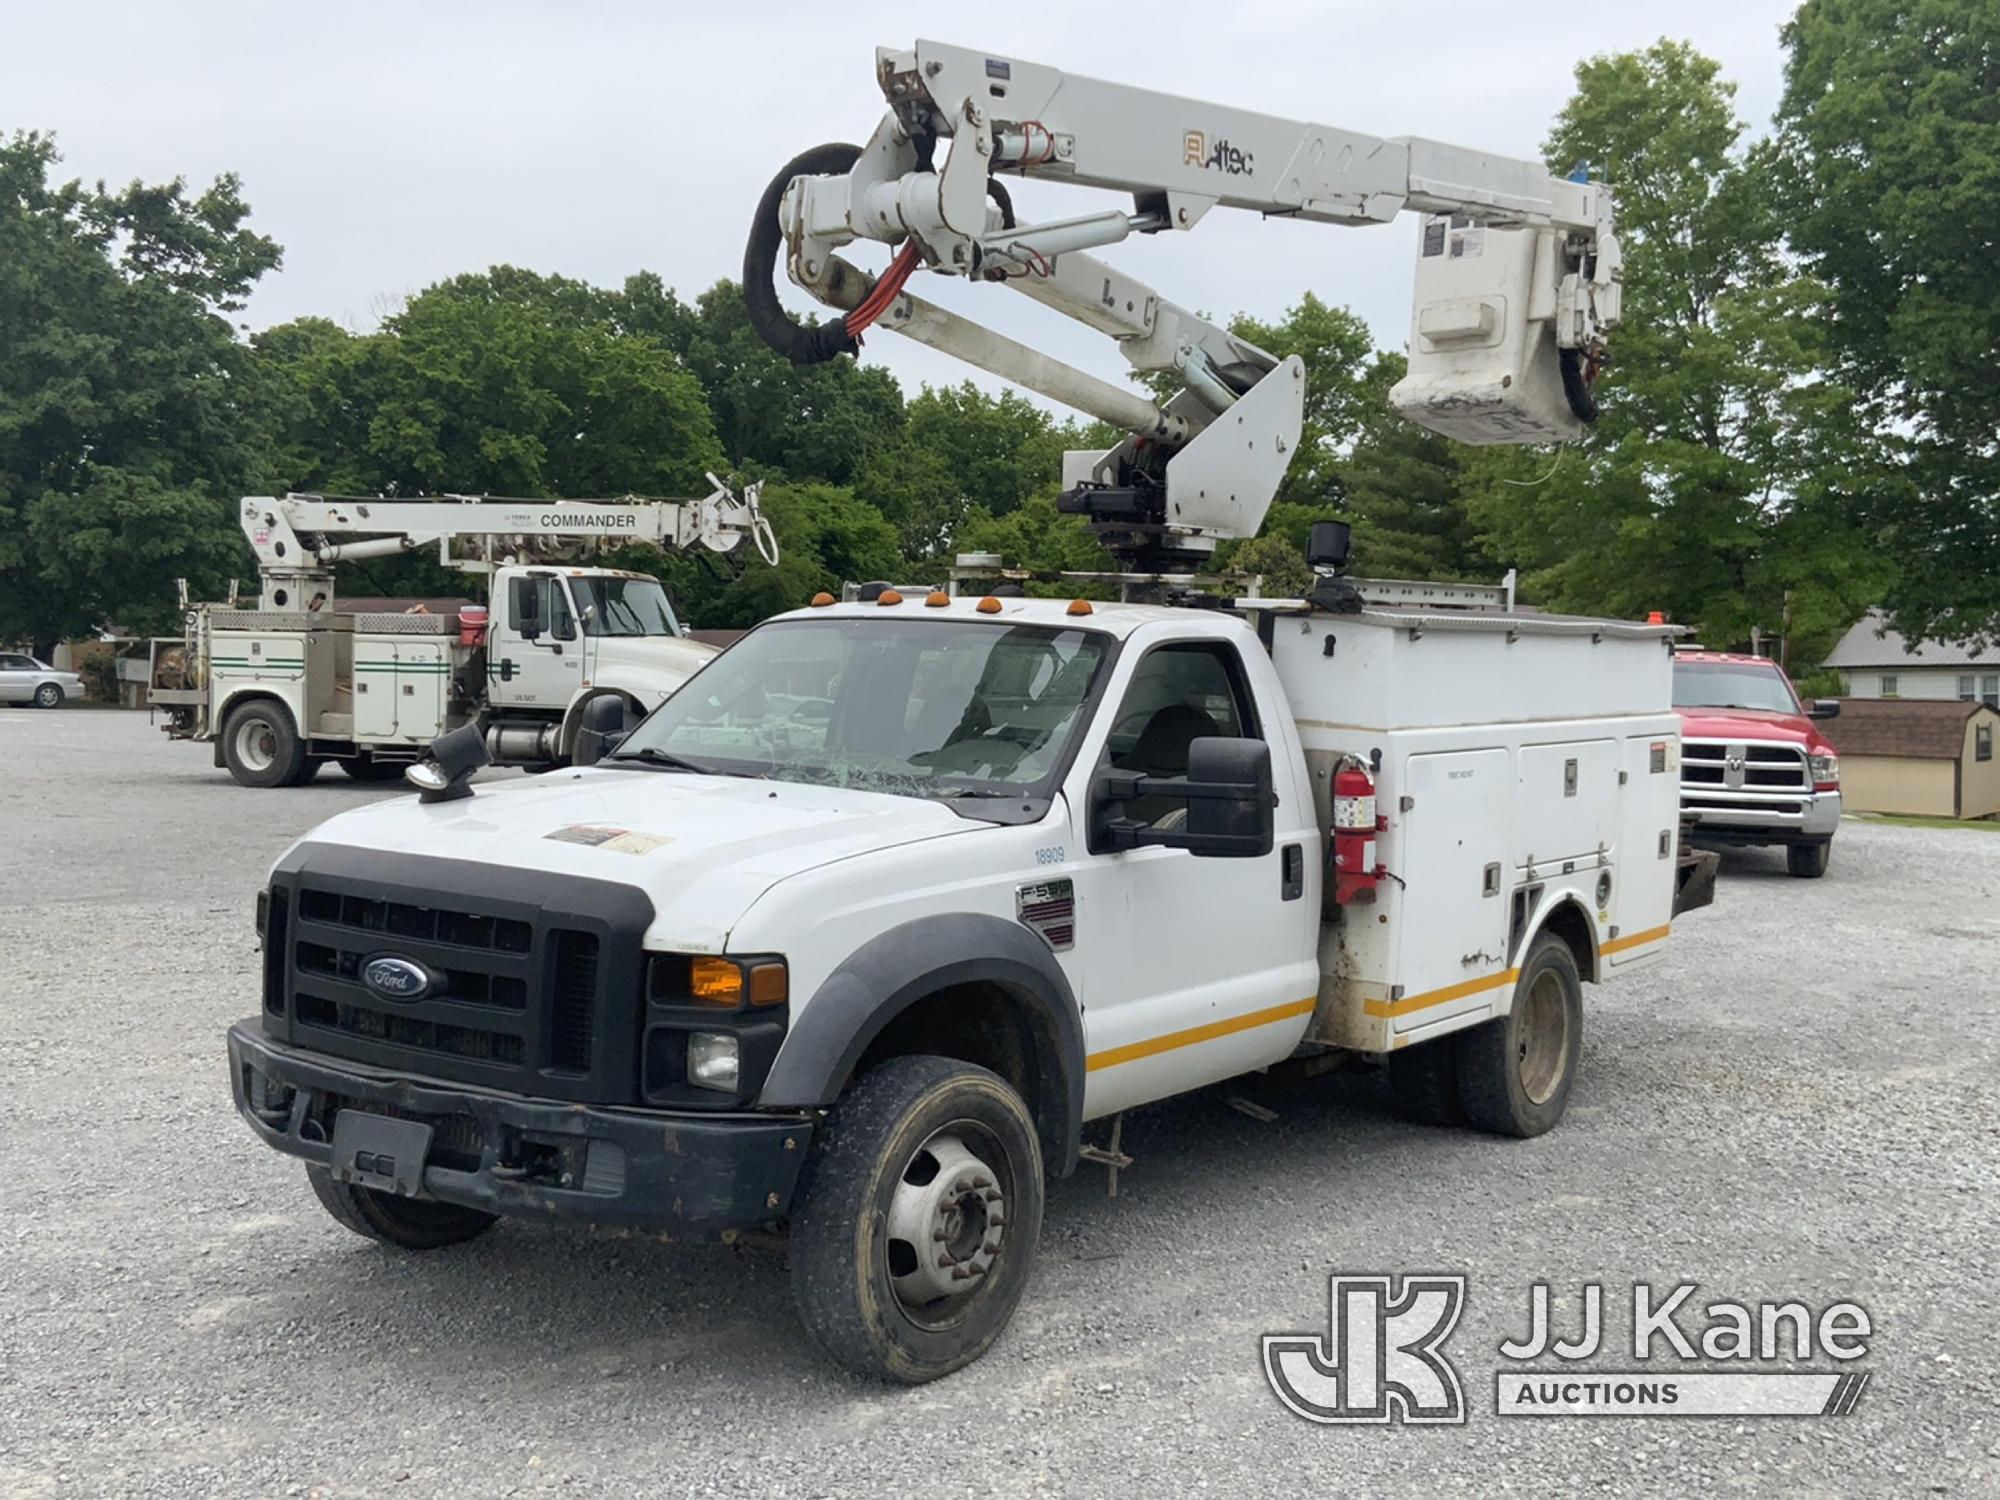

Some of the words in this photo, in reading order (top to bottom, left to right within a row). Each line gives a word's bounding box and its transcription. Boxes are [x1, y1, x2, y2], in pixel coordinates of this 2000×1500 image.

[540, 514, 636, 527] COMMANDER
[1035, 846, 1065, 865] 18909
[370, 964, 409, 990] Ford
